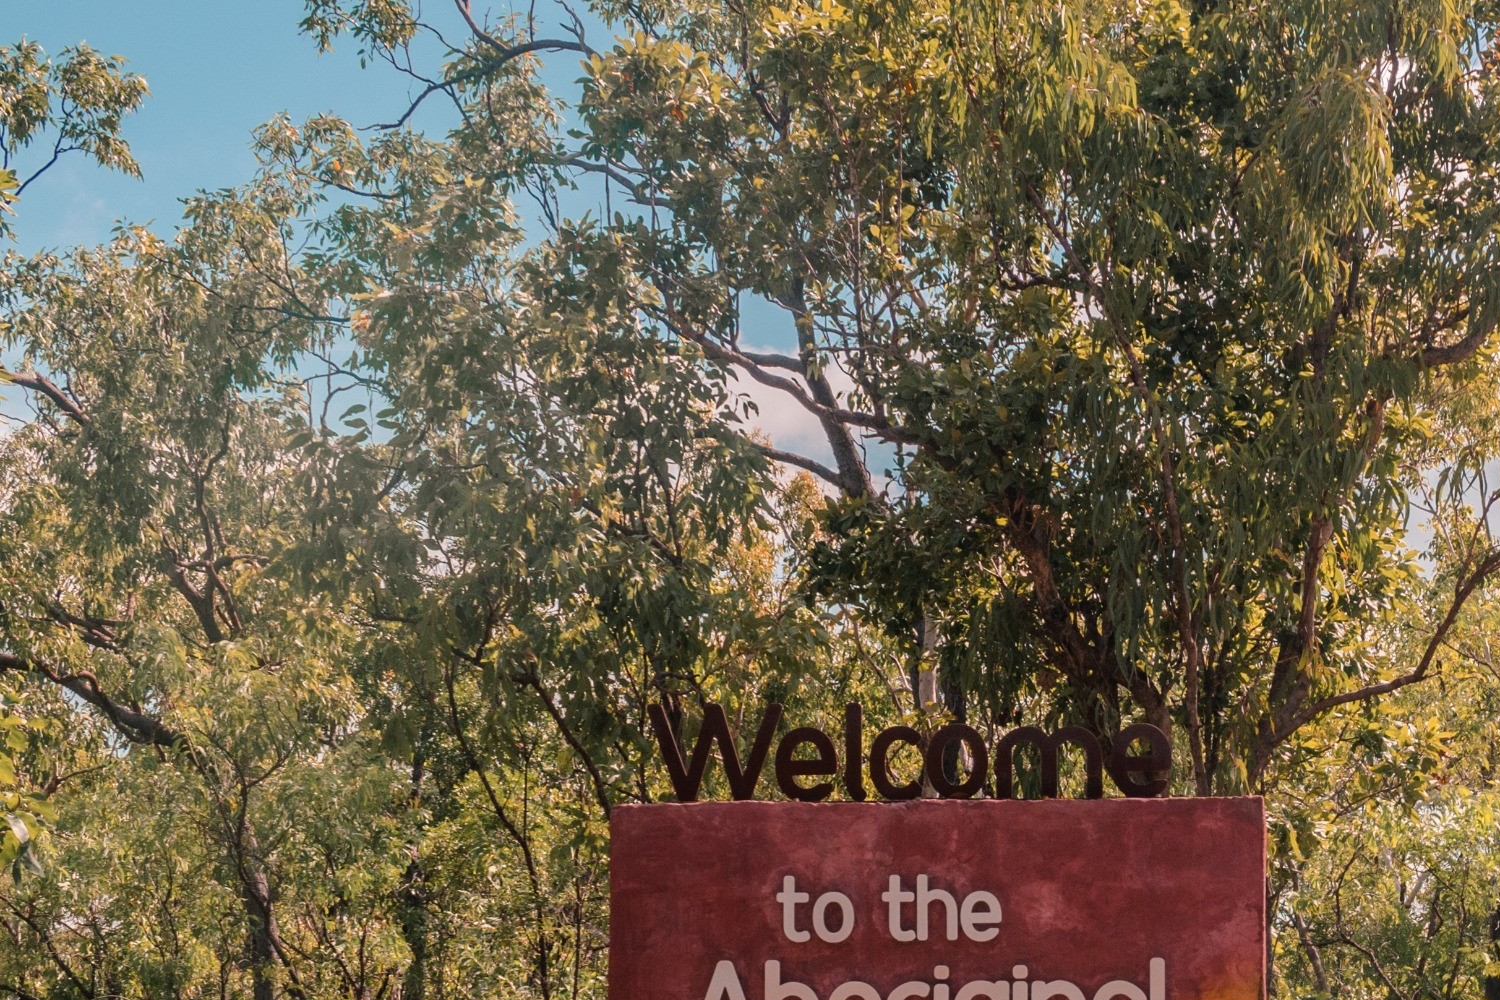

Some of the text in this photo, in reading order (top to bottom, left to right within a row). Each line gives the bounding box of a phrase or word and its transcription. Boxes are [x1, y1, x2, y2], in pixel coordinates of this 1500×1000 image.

[648, 702, 1172, 801] Welcome
[776, 873, 1003, 944] to the
